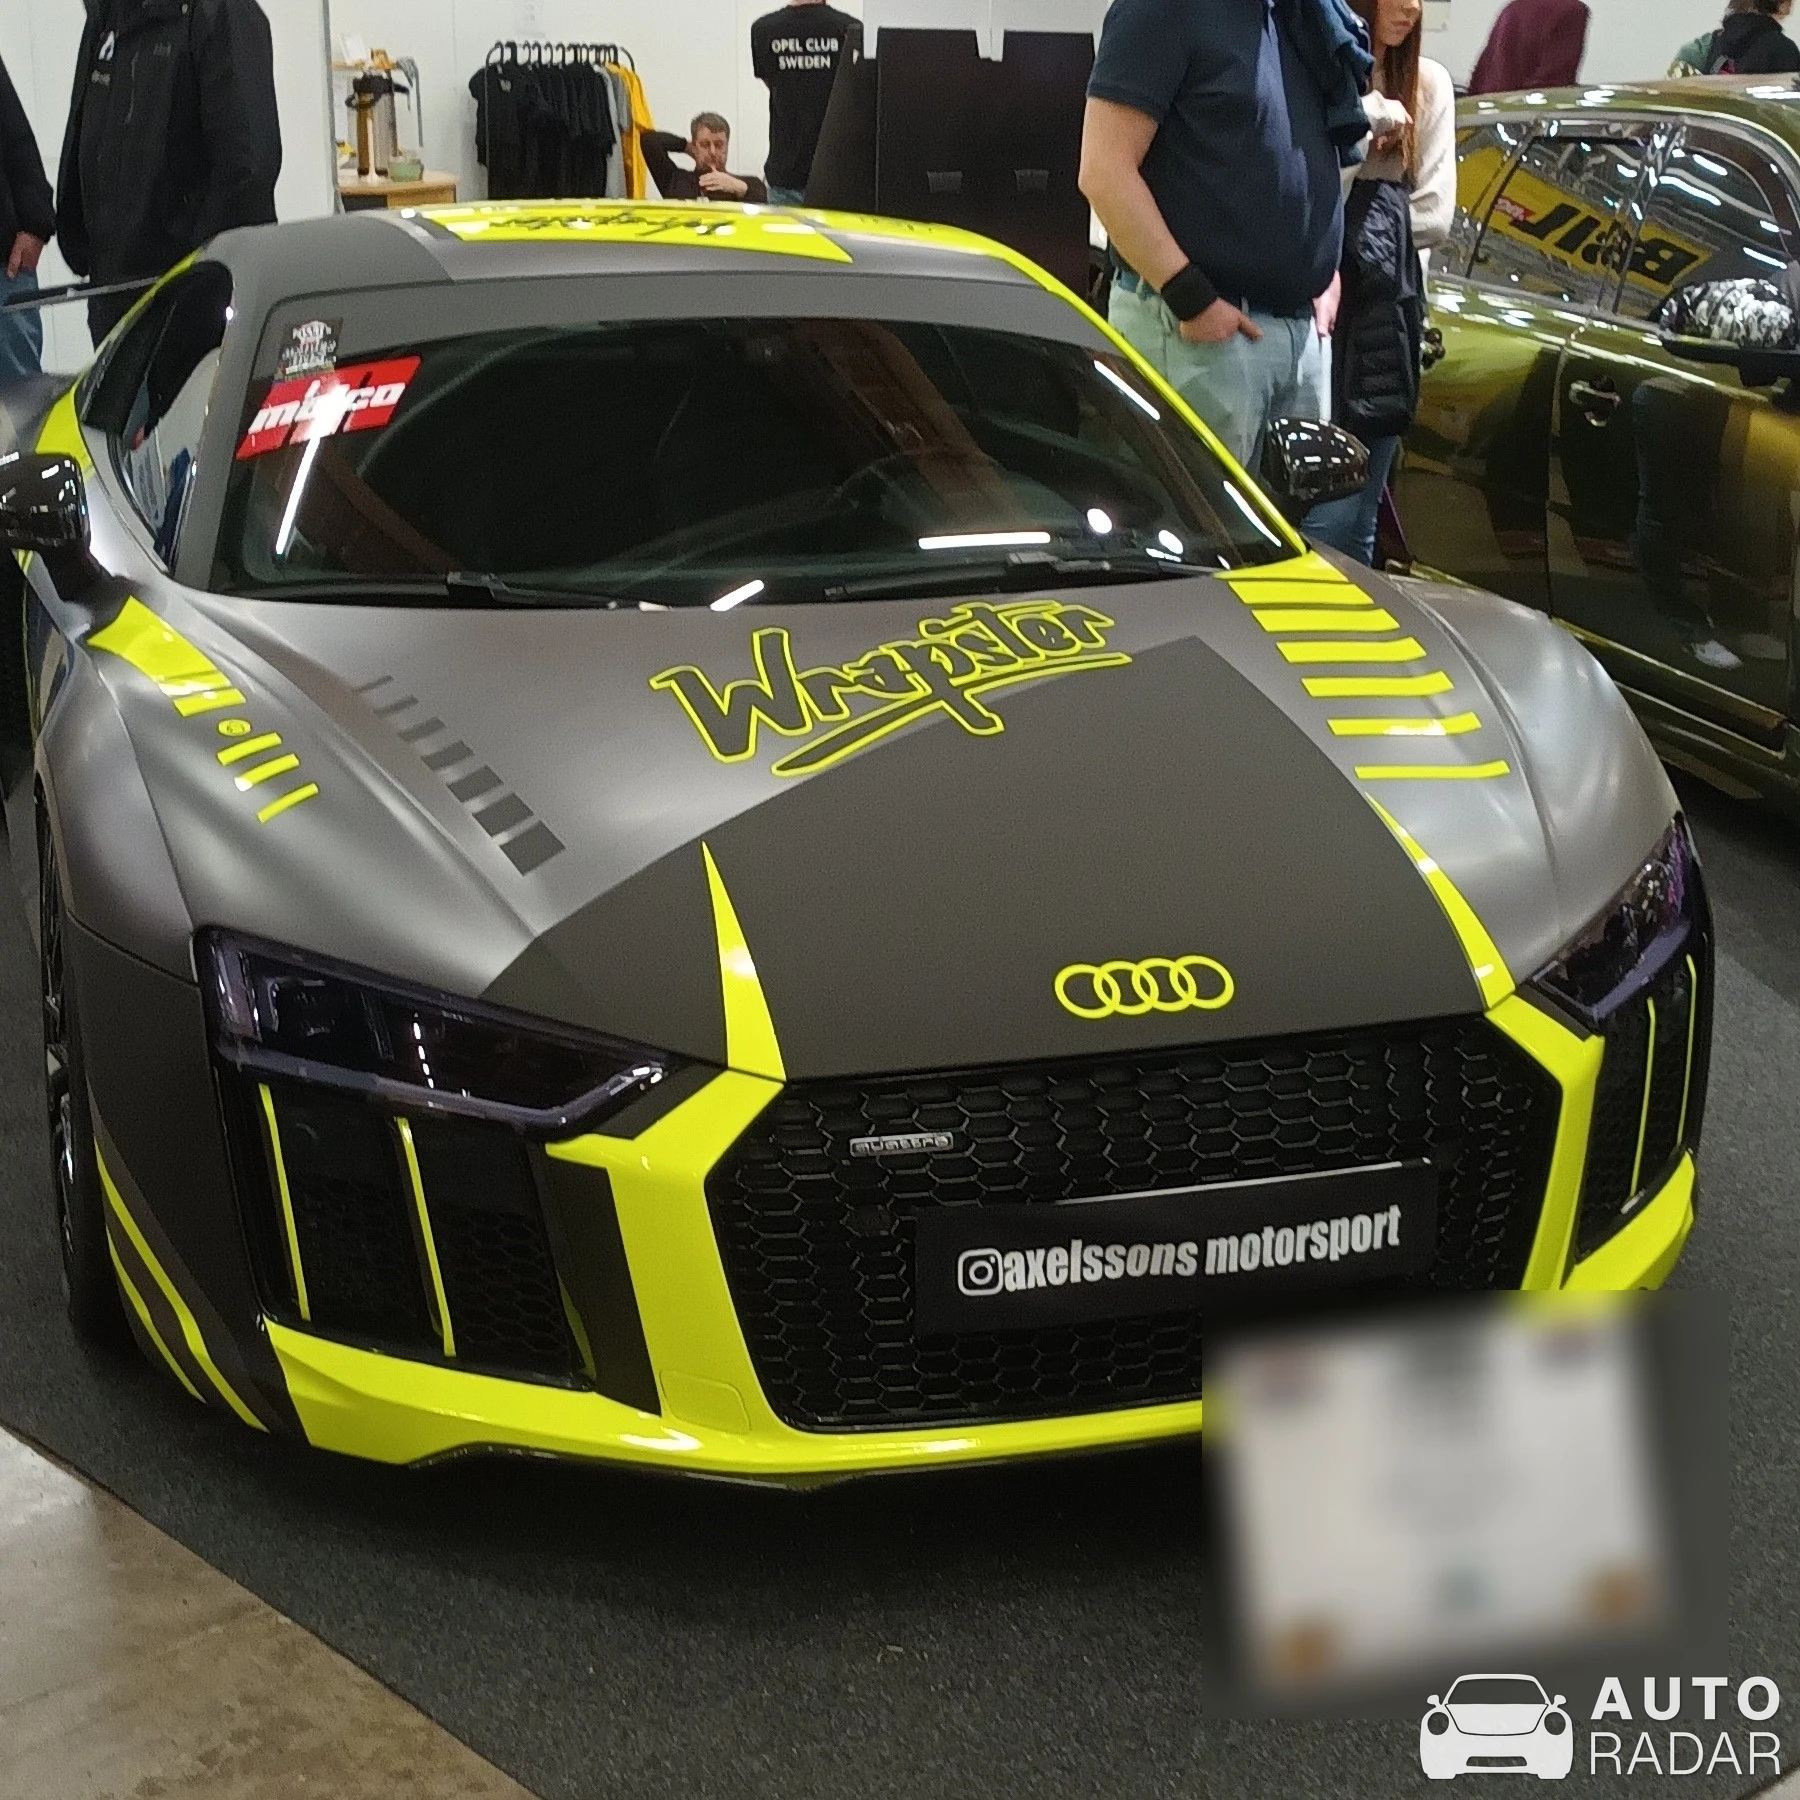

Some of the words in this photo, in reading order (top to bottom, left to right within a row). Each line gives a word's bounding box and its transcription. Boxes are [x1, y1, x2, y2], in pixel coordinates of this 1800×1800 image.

[771, 38, 803, 53] OPEL
[805, 37, 839, 52] CLUB
[778, 55, 831, 70] SWEDEN
[649, 600, 1120, 766] Wrapster
[1003, 1239, 1198, 1292] axelssons
[1204, 1204, 1401, 1276] motorsport
